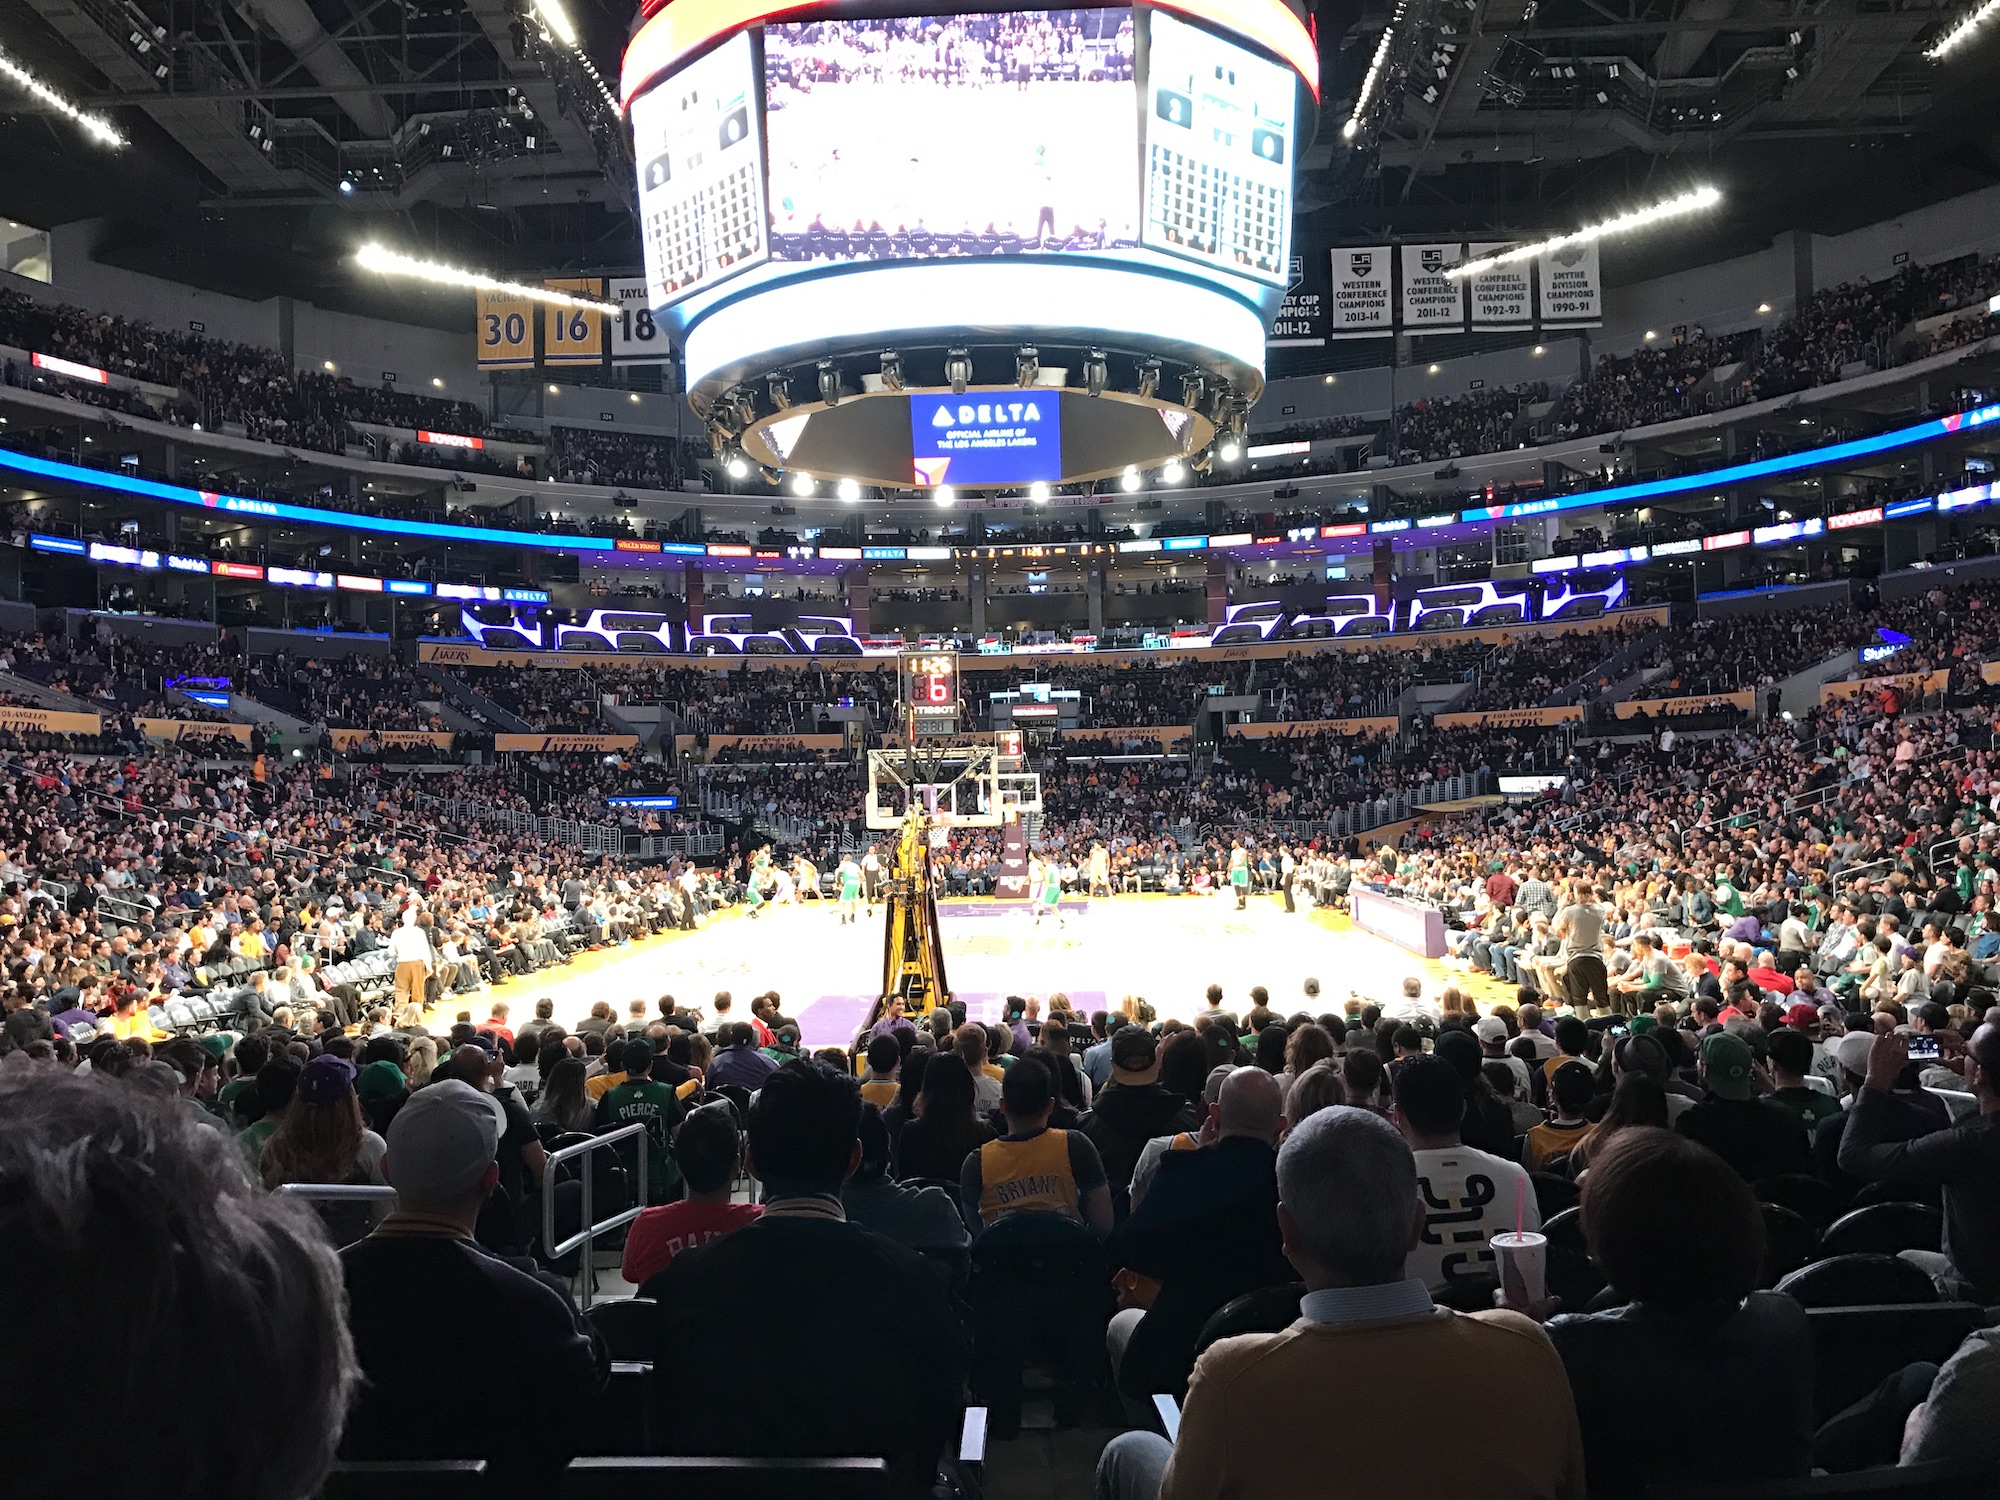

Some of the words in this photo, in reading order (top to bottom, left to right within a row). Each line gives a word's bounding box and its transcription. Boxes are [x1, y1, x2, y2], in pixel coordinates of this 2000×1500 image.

[1479, 274, 1521, 283] CAMPBELL
[1553, 271, 1585, 280] SMYTHE
[1342, 281, 1381, 289] WESTERN
[1413, 277, 1449, 285] WESTE
[1552, 280, 1588, 289] DIVISION
[1407, 286, 1458, 295] CONFERENCE
[1475, 283, 1527, 292] CONFERENCE
[1336, 290, 1388, 299] CONFERENCE
[1478, 293, 1525, 301] CHAMPIONS
[1546, 290, 1594, 299] CHAMPIONS
[1300, 295, 1319, 305] CUP
[1339, 300, 1385, 309] CHAMPIONS
[1410, 296, 1456, 304] CHAMPIONS
[1482, 305, 1520, 314] 1992-93
[1552, 302, 1590, 312] 1990-91
[1345, 312, 1380, 321] 2013-14
[1416, 308, 1450, 317] 2011-12
[484, 313, 526, 346] 30
[556, 309, 589, 342] 16
[622, 309, 656, 342] 18
[958, 402, 1041, 424] DELTA
[946, 430, 982, 439] OFFICIAL
[983, 428, 1014, 438] AIRLINE
[1015, 428, 1027, 437] OF
[428, 432, 474, 448] TOYOTA
[937, 440, 953, 449] THE
[954, 439, 969, 448] LOS
[970, 438, 1006, 448] ANGELES
[1007, 437, 1037, 447] LAKERS
[238, 500, 278, 514] DELTA
[1523, 500, 1559, 512] DELTA
[1829, 510, 1882, 528] TOYOTA
[168, 555, 207, 572] StubHub
[516, 590, 548, 600] DELTA
[431, 646, 471, 663] LAKERS
[909, 657, 952, 673] 11:26
[929, 674, 947, 701] 6
[916, 706, 956, 714] TISSOT
[1507, 710, 1544, 718] ANGELES
[14, 712, 47, 720] ANGELES
[201, 724, 230, 732] ANGEL
[1009, 741, 1018, 754] 6
[1069, 1036, 1097, 1044] DELTA
[619, 1102, 659, 1120] PIERCE
[996, 1175, 1059, 1203] BRYANT
